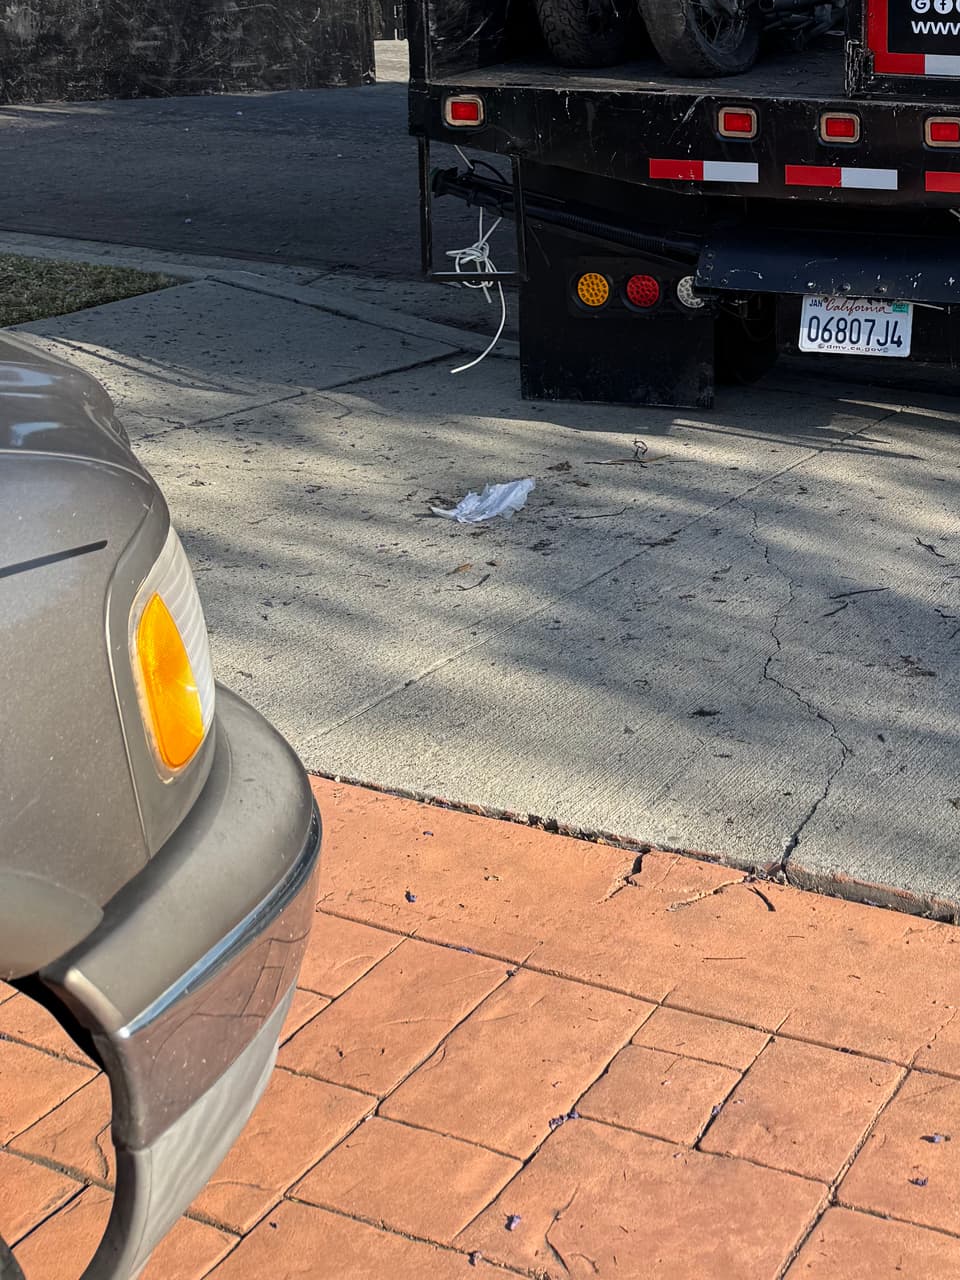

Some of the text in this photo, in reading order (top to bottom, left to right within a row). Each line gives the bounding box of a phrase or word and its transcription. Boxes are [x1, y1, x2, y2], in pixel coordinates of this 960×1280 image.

[809, 299, 823, 308] JAN
[825, 297, 893, 316] California
[807, 315, 903, 348] 06807J4
